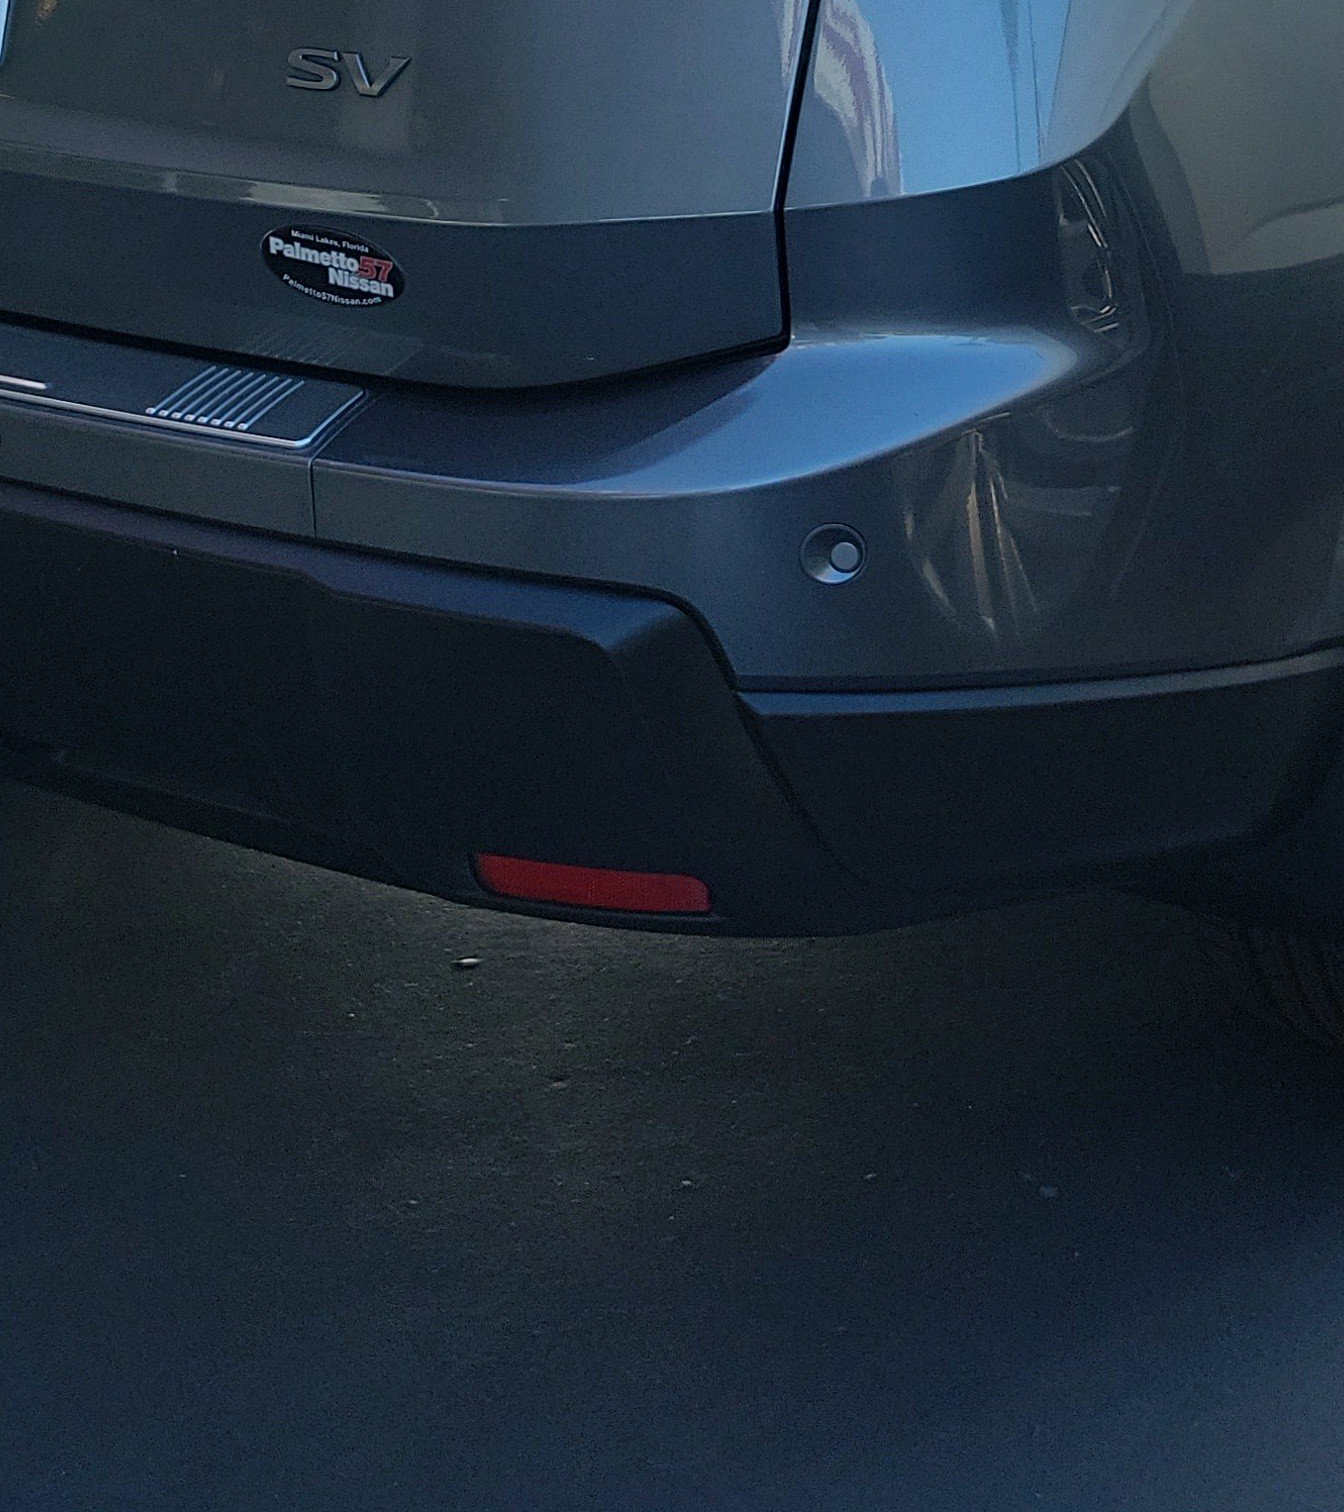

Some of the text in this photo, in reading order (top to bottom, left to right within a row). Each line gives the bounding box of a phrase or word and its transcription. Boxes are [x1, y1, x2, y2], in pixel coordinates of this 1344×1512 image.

[285, 47, 412, 98] SV
[291, 229, 314, 241] Miami
[342, 240, 369, 254] Florida
[328, 267, 394, 298] Nissan
